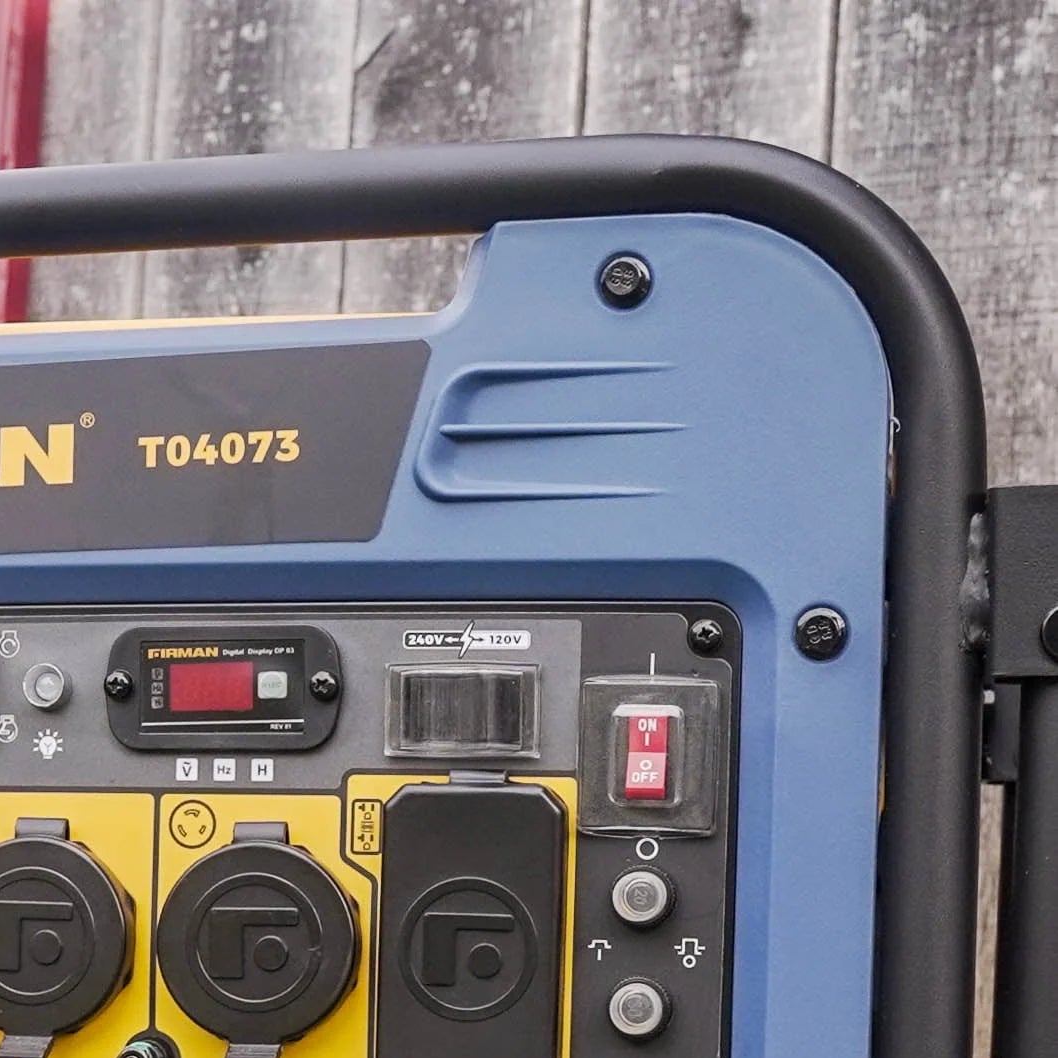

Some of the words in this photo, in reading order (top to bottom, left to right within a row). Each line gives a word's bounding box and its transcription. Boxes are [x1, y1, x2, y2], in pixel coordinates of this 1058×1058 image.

[138, 429, 300, 468] T04073
[407, 634, 444, 646] 240V
[489, 635, 522, 645] 120V
[148, 647, 218, 660] FIRMAN
[638, 719, 657, 731] ON
[217, 765, 231, 775] Hz
[258, 765, 267, 776] H
[632, 772, 658, 783] OFF
